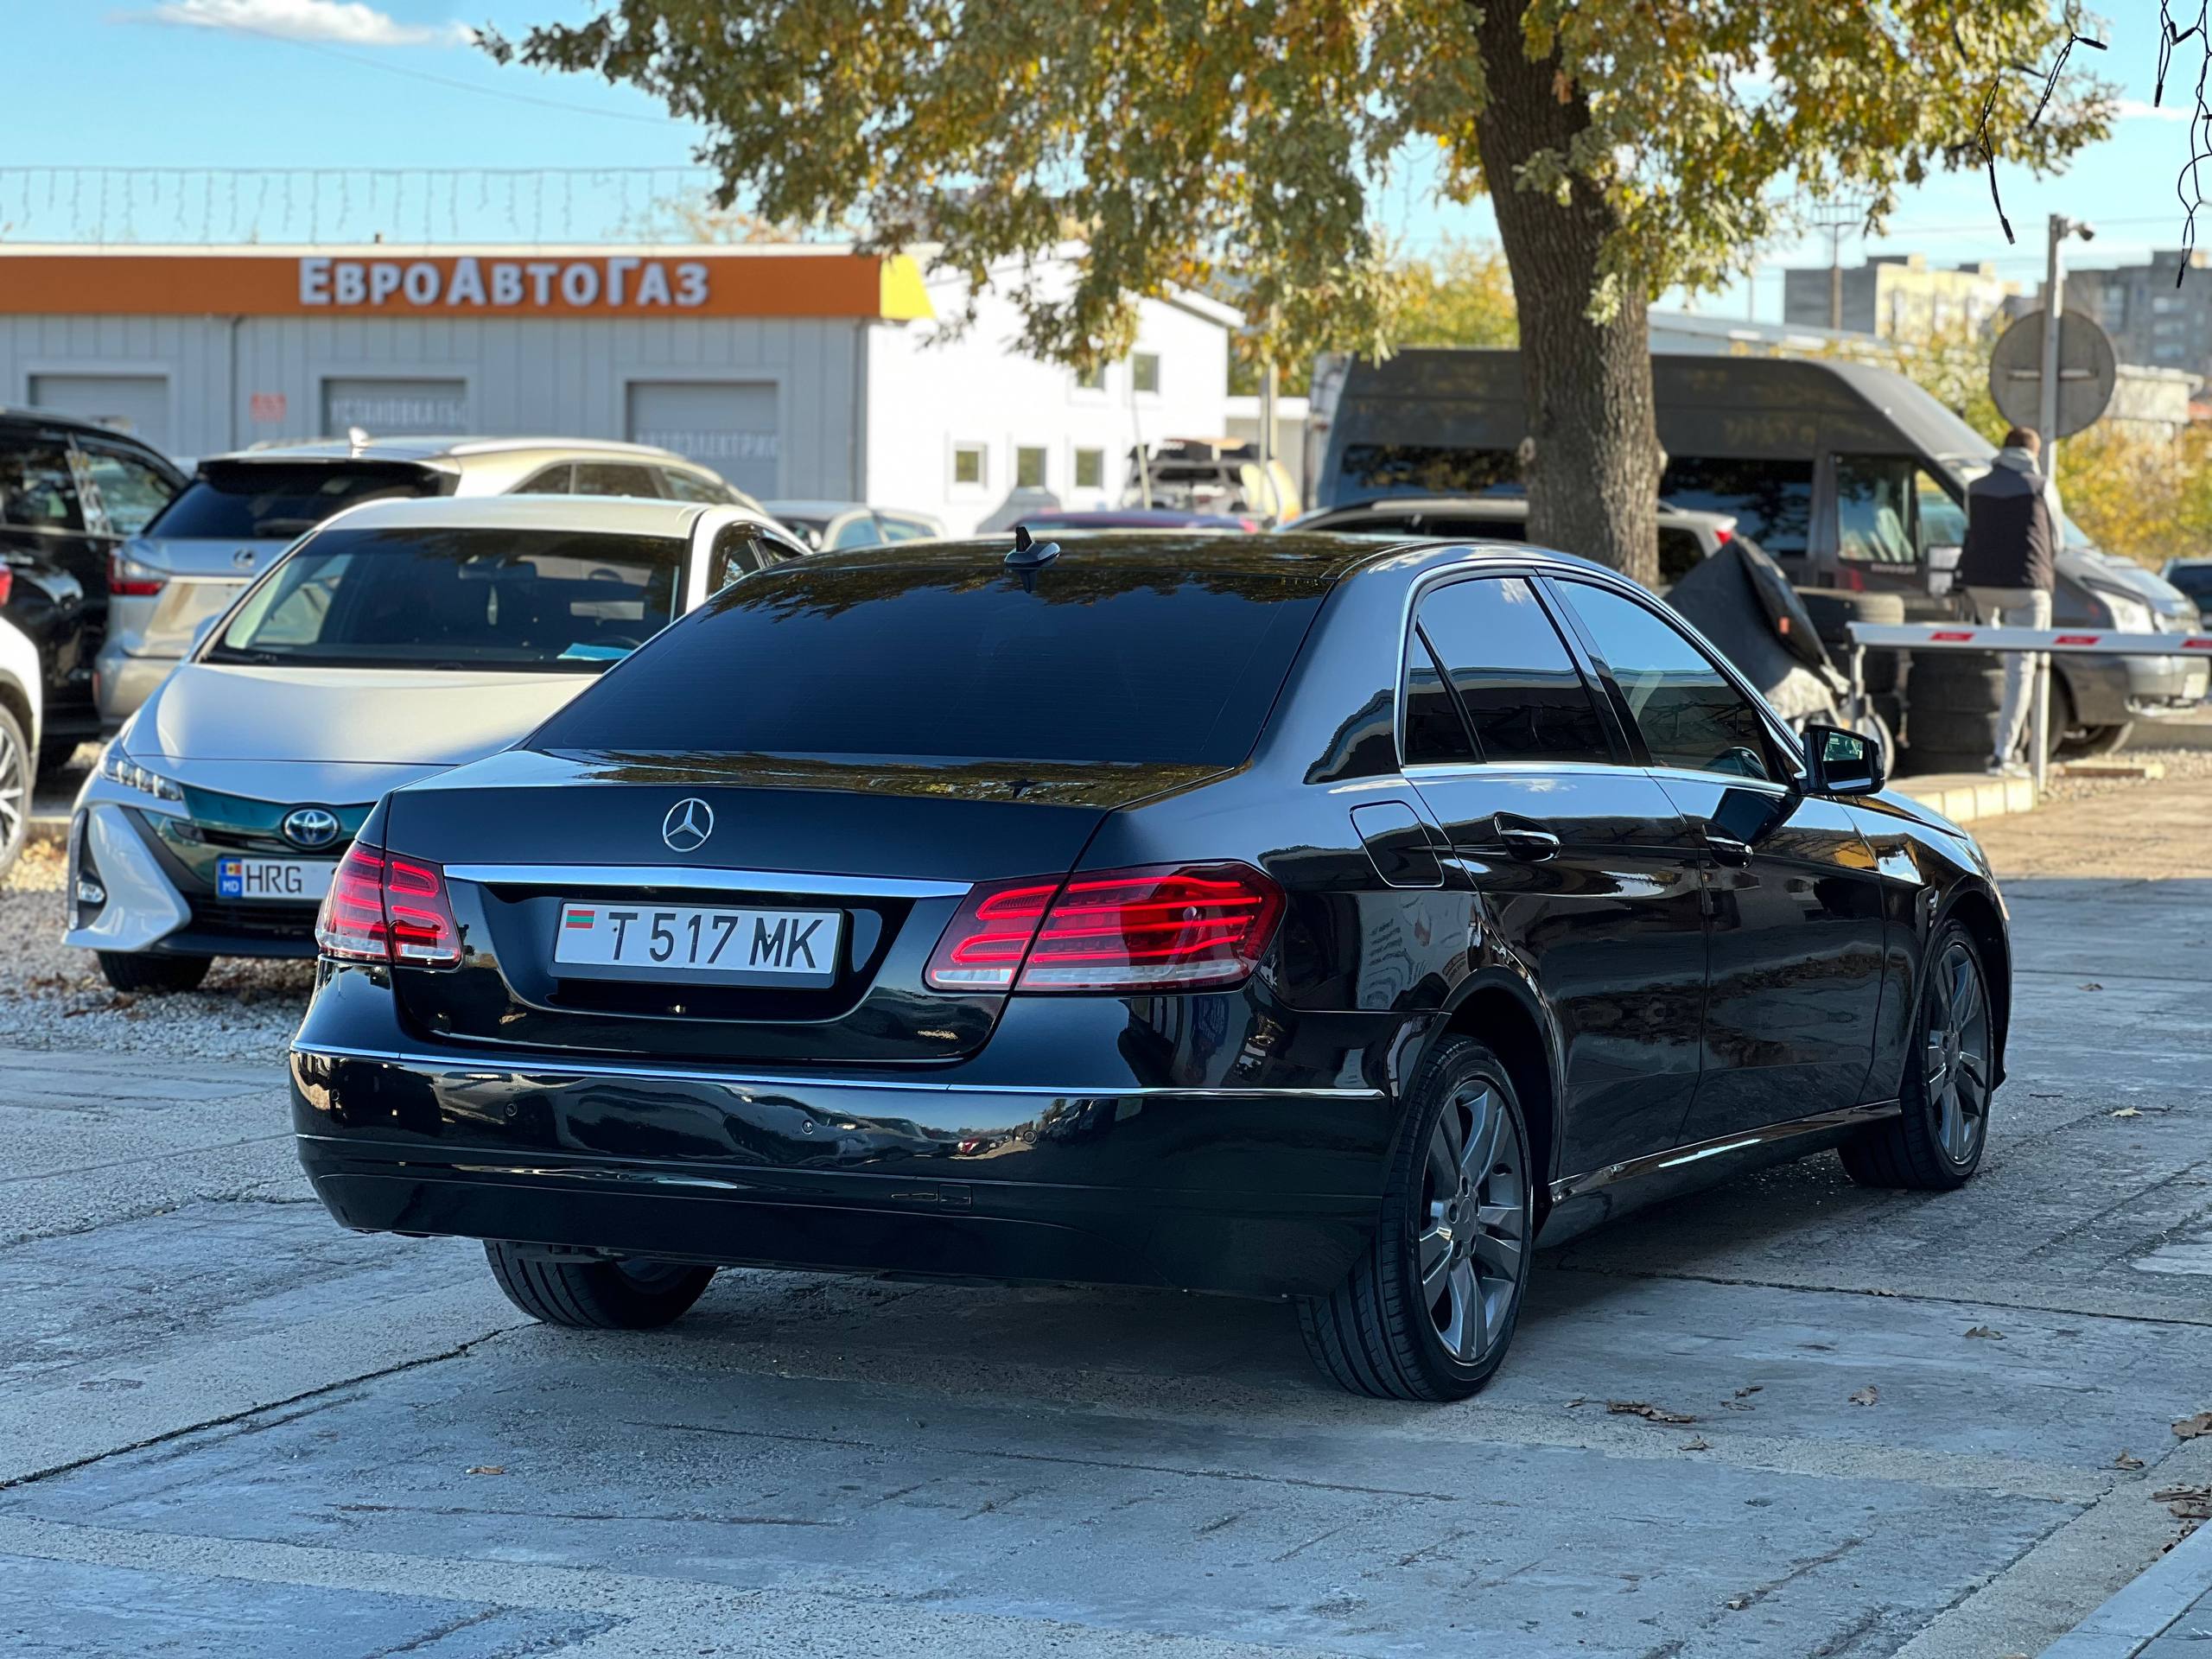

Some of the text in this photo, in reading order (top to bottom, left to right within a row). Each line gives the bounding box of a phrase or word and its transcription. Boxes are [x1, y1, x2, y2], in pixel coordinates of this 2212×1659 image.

[222, 880, 240, 893] MD
[245, 864, 302, 893] HRG
[608, 912, 823, 969] T 517 MK
